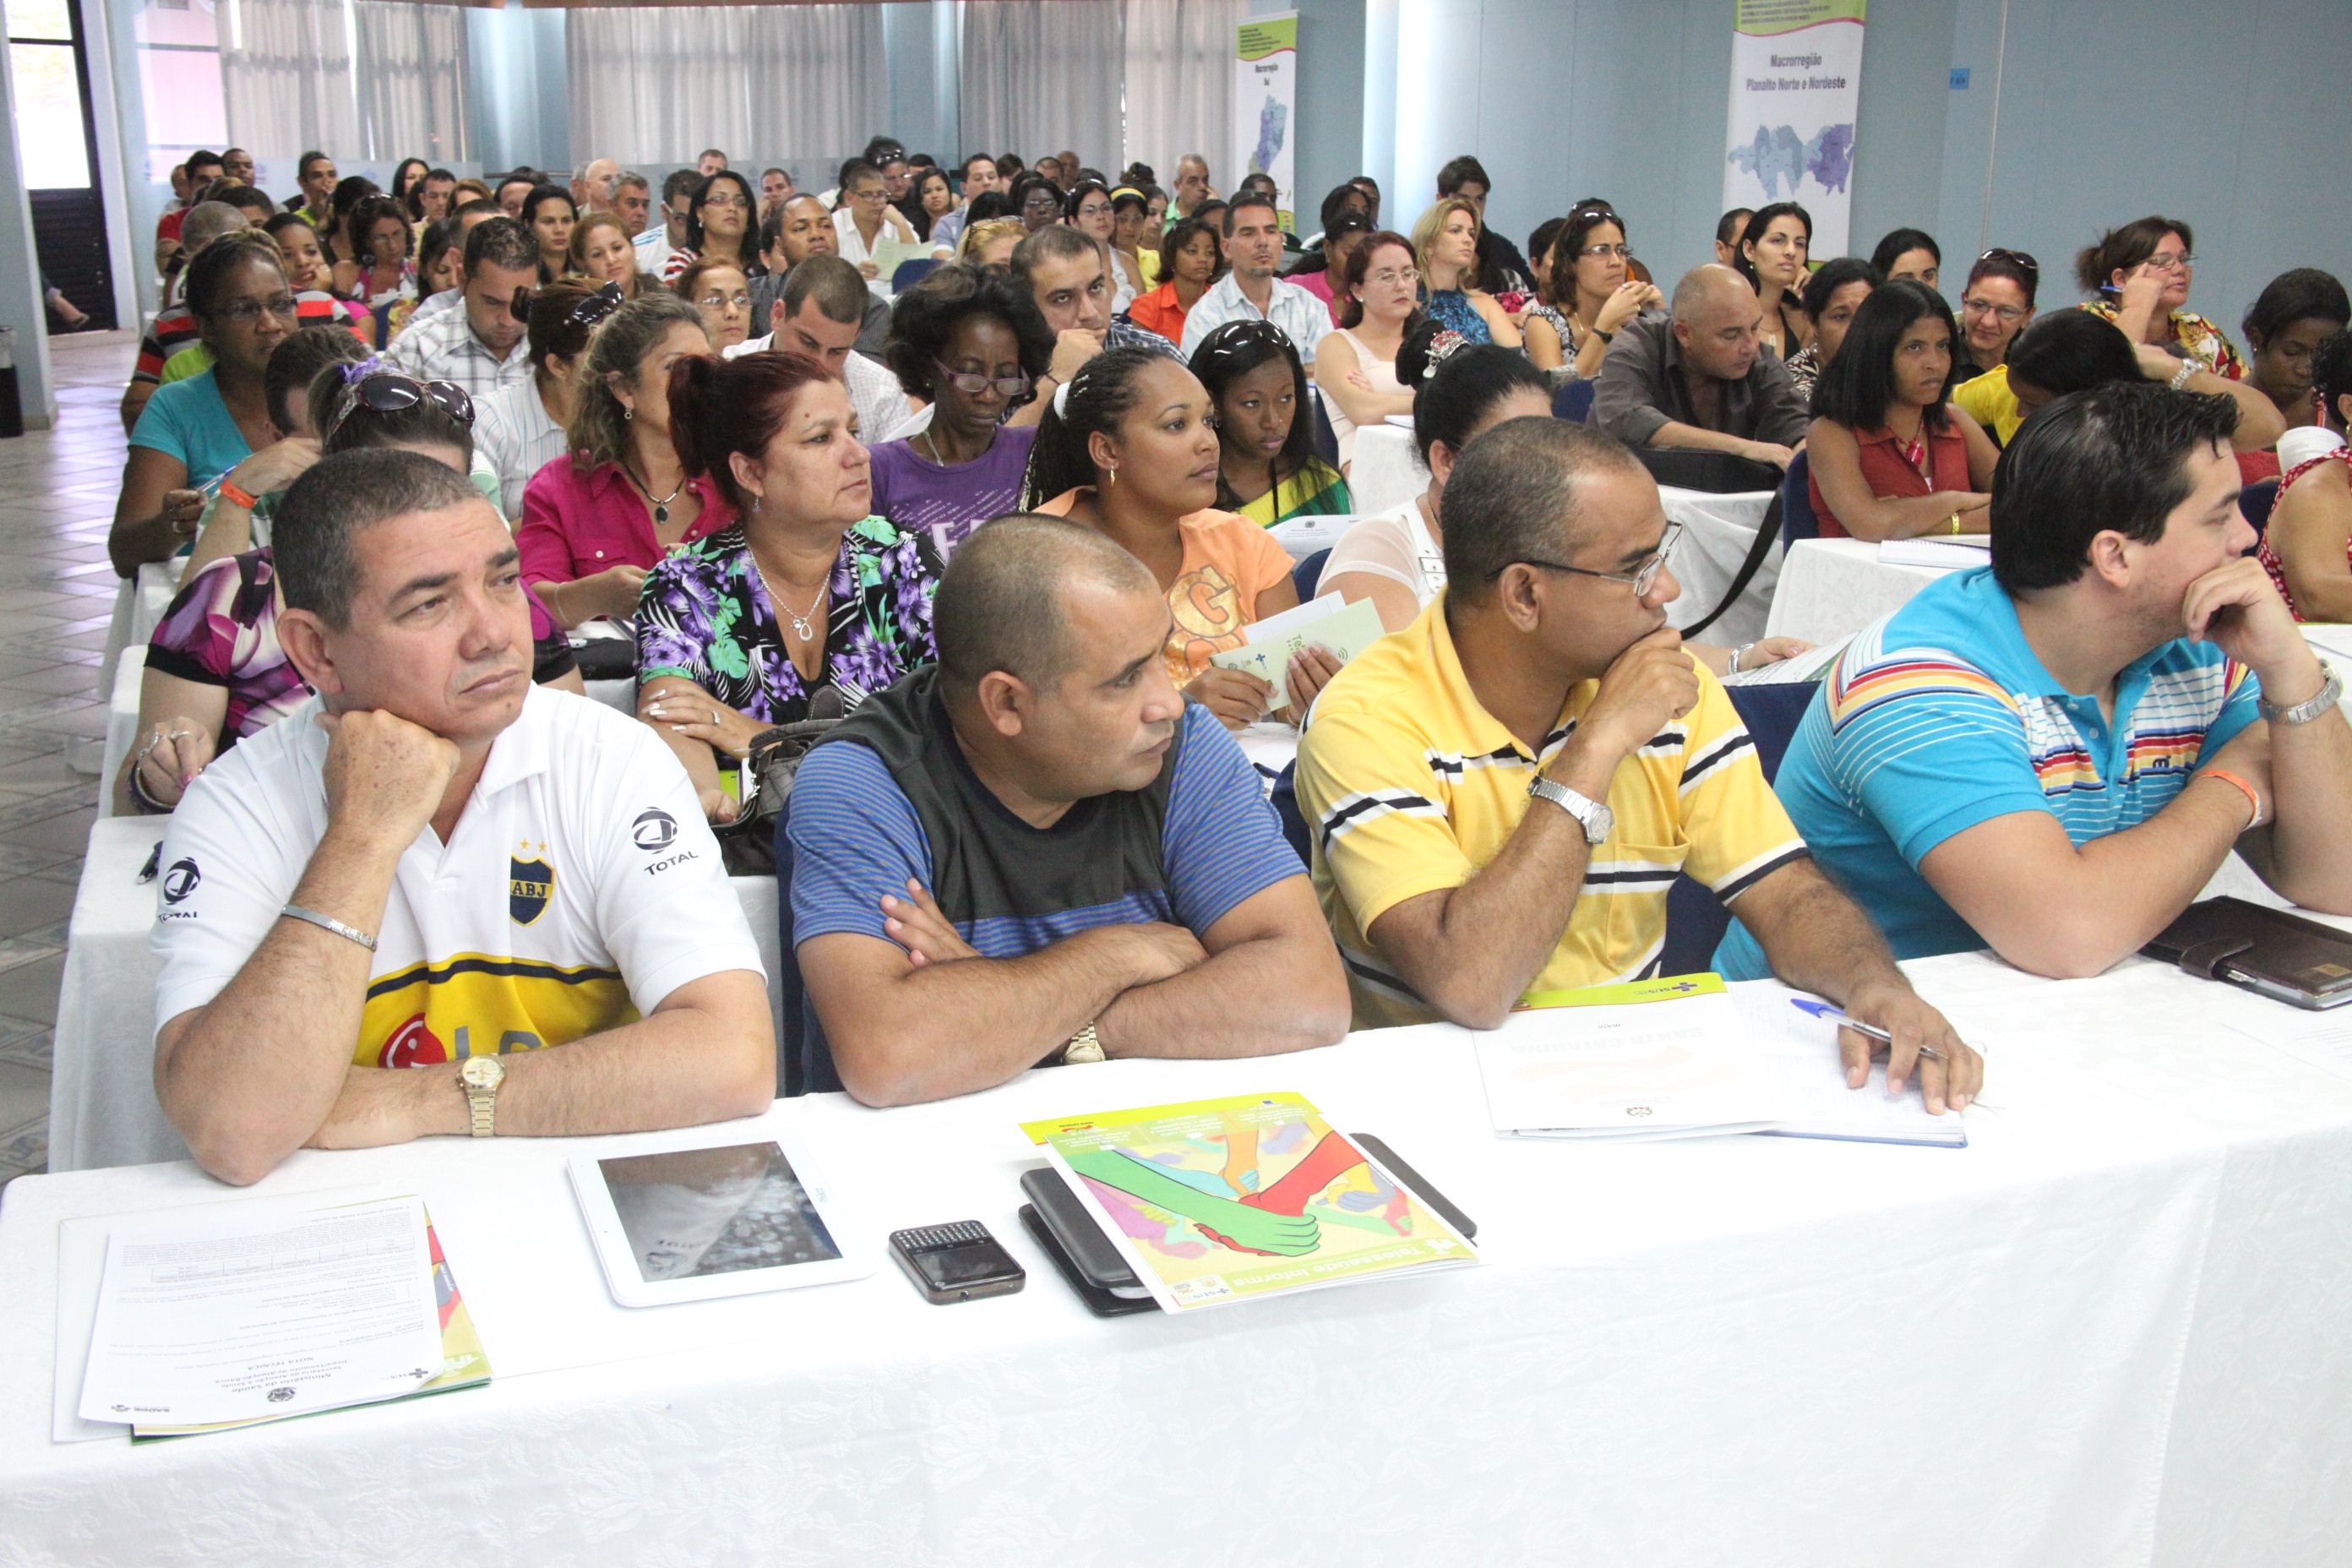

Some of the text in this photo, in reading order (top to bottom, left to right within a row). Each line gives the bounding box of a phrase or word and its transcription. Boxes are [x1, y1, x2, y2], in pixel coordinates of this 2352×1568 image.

[1771, 52, 1822, 69] Macrorregião
[1778, 77, 1799, 90] Norte
[1802, 79, 1807, 90] e
[1809, 76, 1845, 89] Nordeste
[644, 851, 699, 875] TOTAL
[1511, 1038, 1625, 1055] CATARINA
[814, 1188, 830, 1203] Philco
[1312, 1246, 1424, 1275] Telessaúde
[1232, 1267, 1310, 1288] Informa
[1193, 1291, 1217, 1299] SUS
[247, 1357, 313, 1372] NOTA TÉCNICA
[289, 1359, 347, 1373] Departamento
[302, 1365, 342, 1375] Secretaria
[242, 1370, 275, 1381] Atenção
[254, 1374, 287, 1384] Atenção
[280, 1373, 331, 1386] Ministério
[231, 1385, 263, 1394] Saúde
